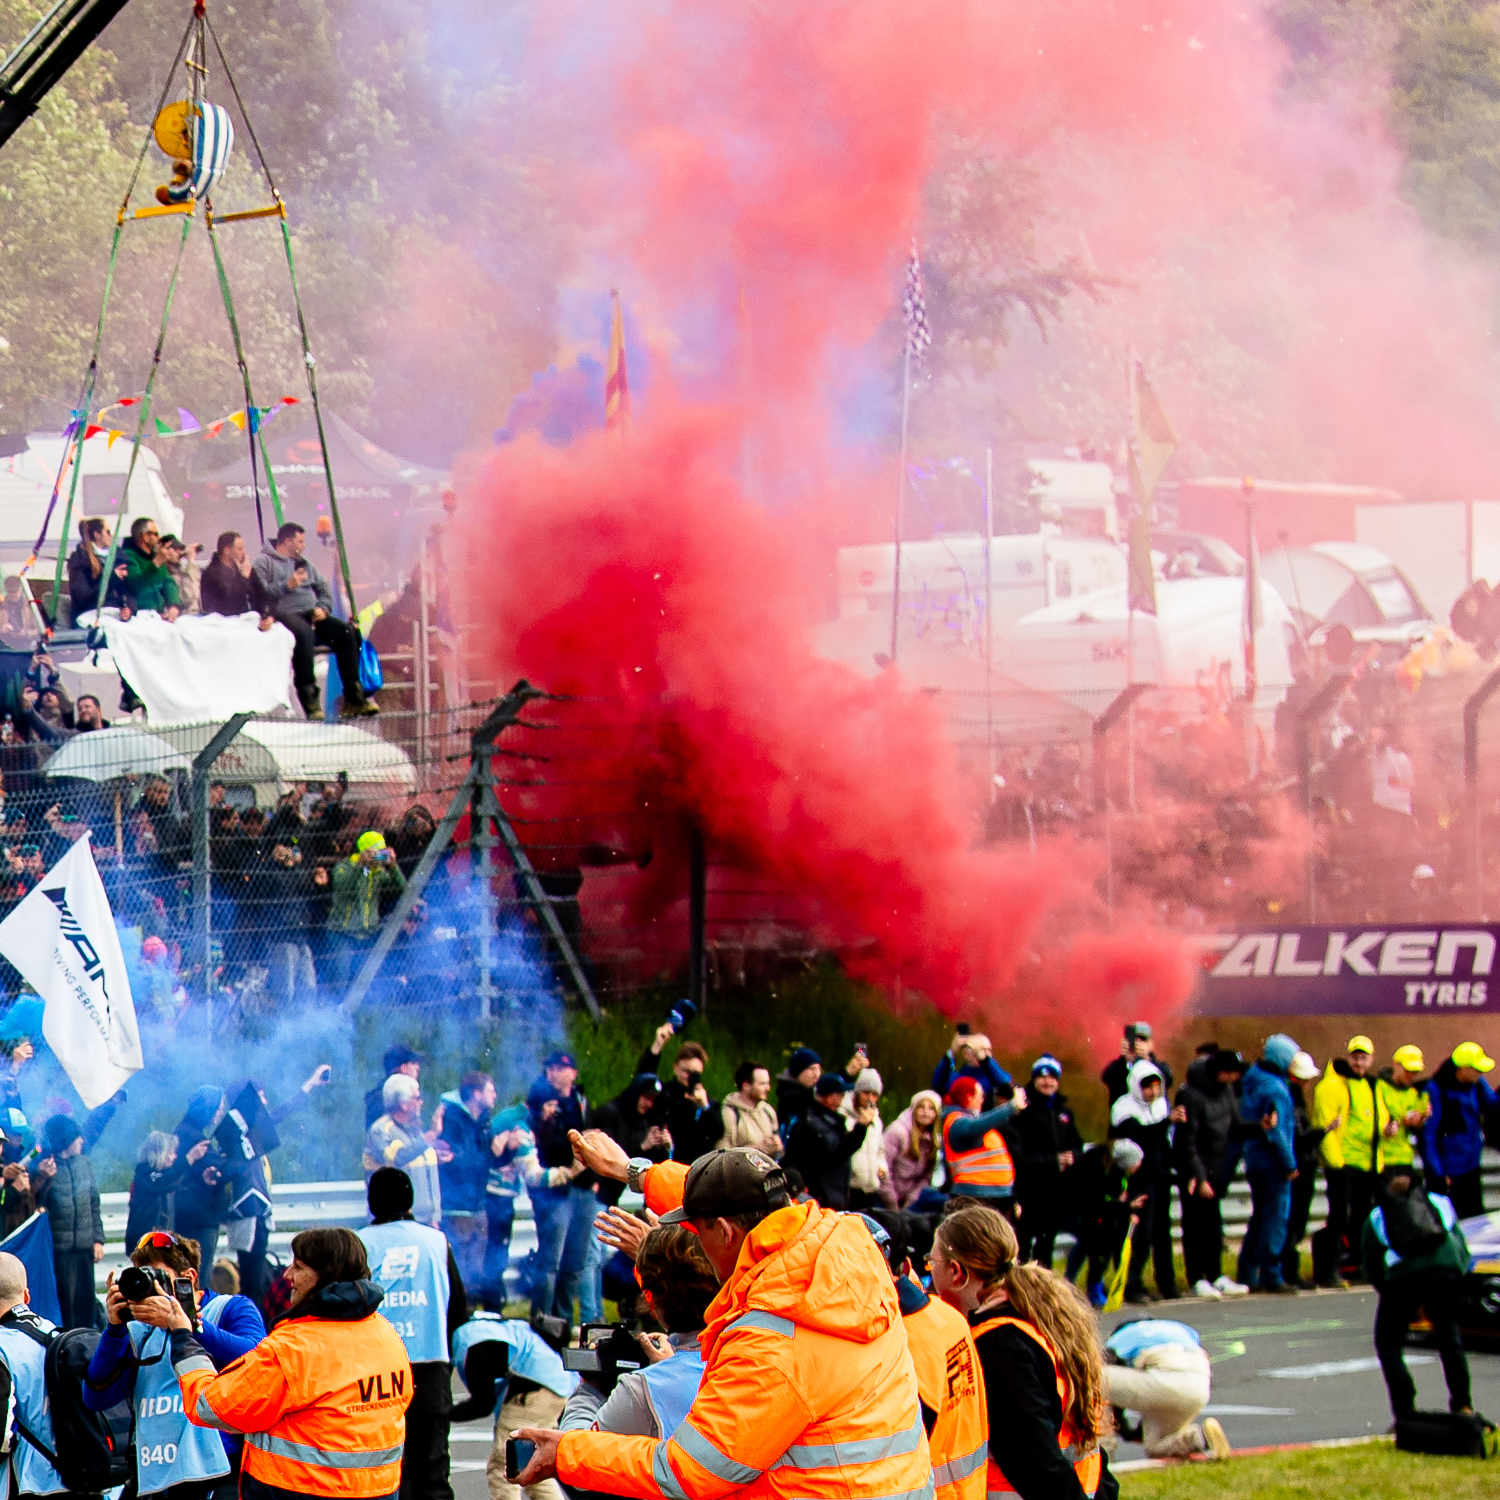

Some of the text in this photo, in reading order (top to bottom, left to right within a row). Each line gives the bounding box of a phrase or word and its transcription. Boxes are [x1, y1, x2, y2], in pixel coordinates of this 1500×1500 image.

[1183, 929, 1497, 977] FALKEN
[1404, 980, 1488, 1007] TYRES
[357, 1370, 406, 1403] VLN
[139, 1443, 179, 1467] 840
